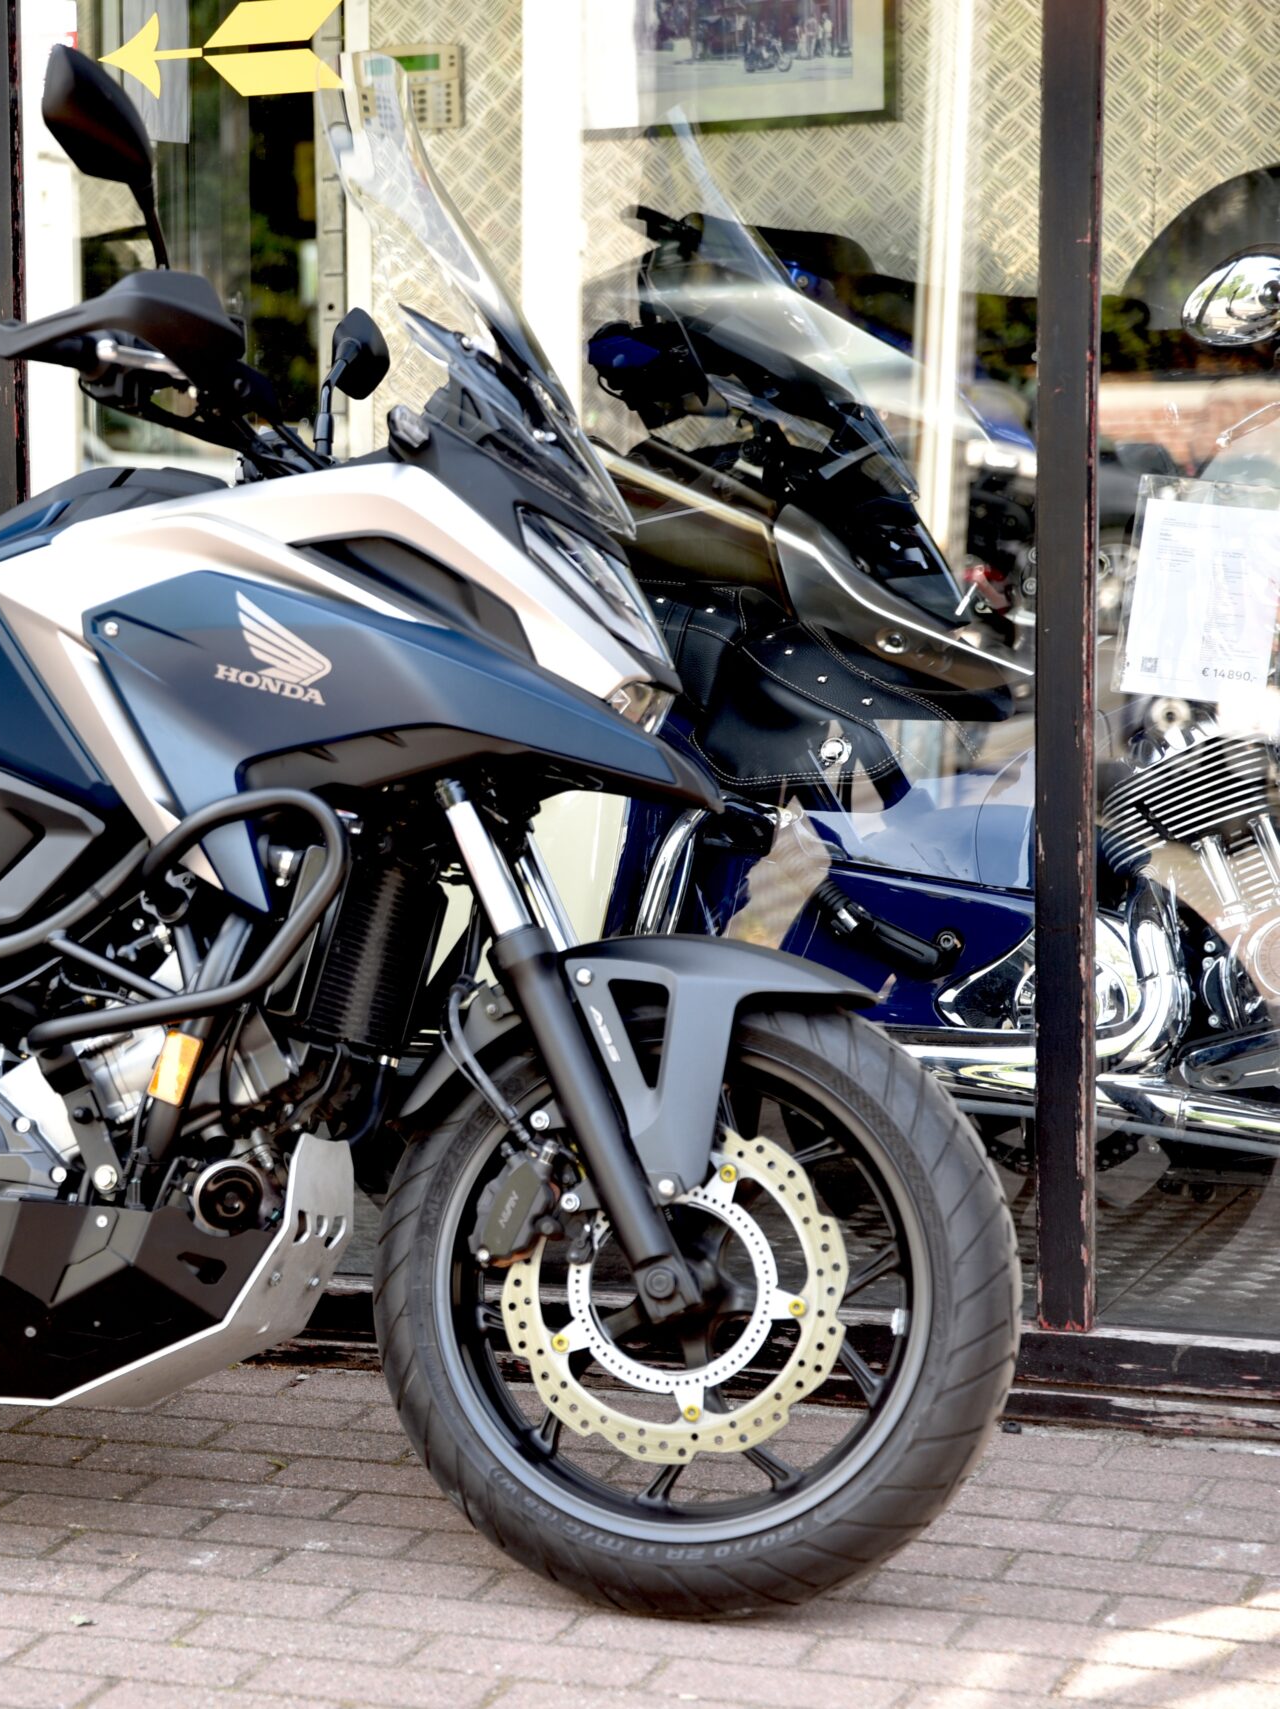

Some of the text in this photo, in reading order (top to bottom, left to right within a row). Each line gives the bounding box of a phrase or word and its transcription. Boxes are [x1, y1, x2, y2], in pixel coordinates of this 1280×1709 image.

[214, 664, 326, 706] HONDA
[1201, 667, 1210, 678] €
[589, 1005, 621, 1062] ABS
